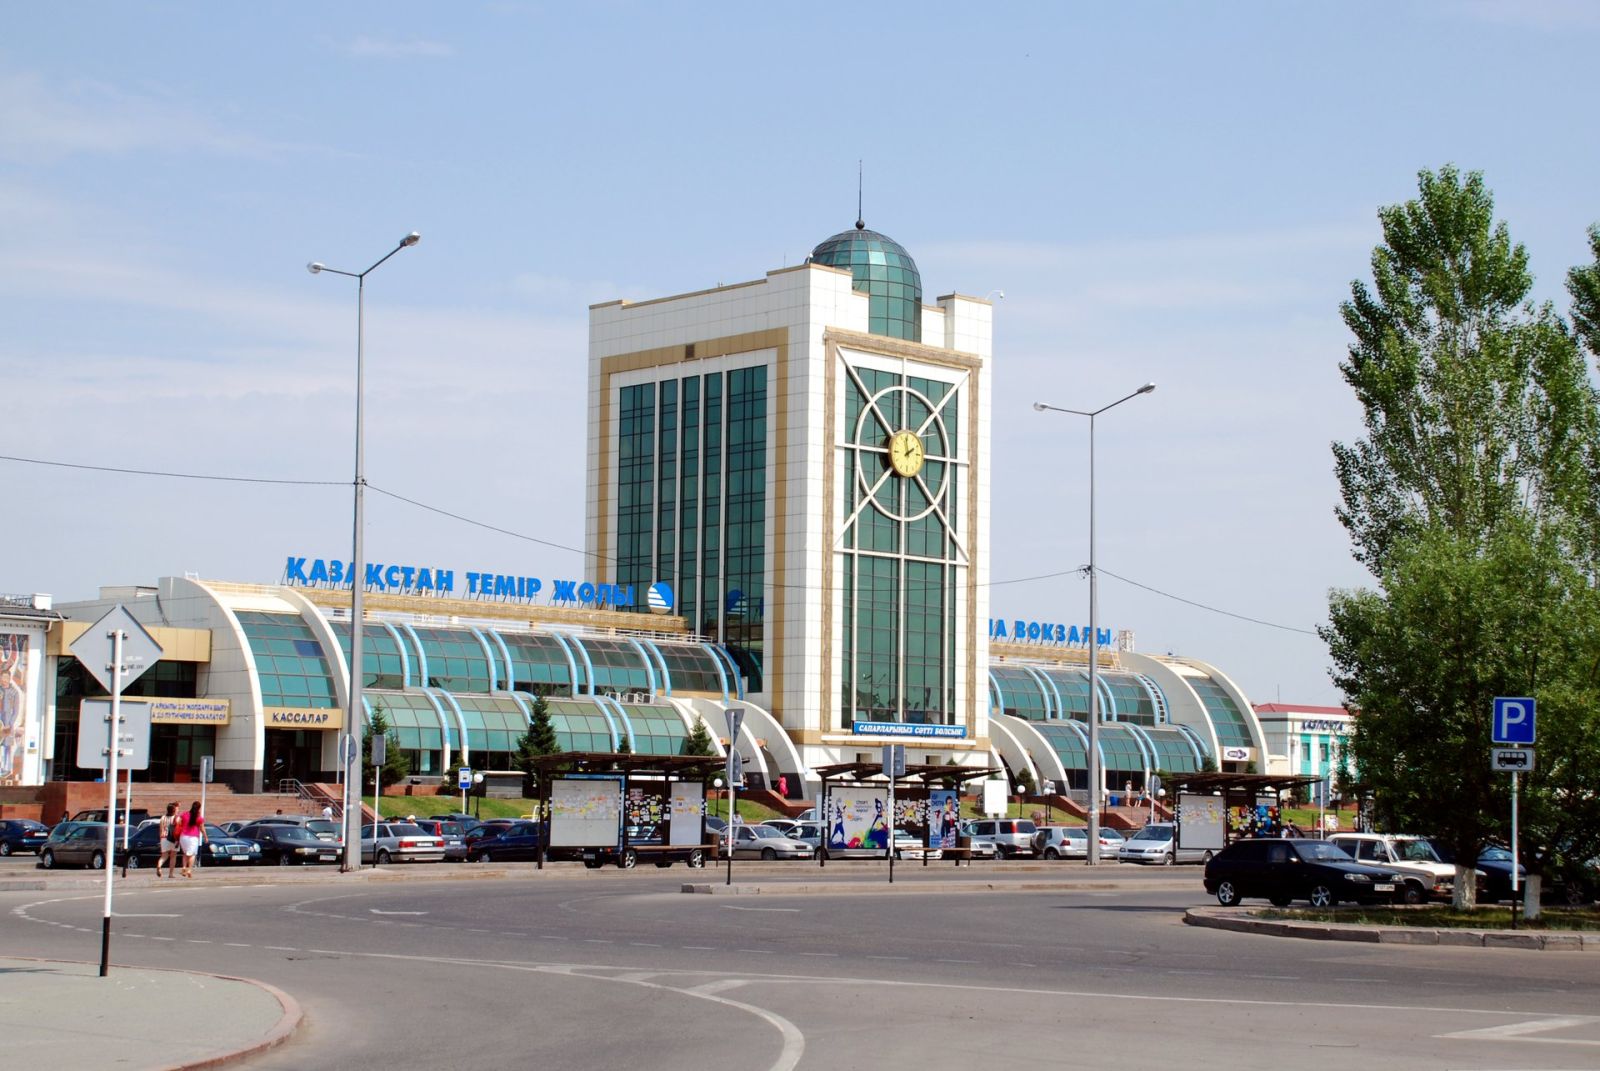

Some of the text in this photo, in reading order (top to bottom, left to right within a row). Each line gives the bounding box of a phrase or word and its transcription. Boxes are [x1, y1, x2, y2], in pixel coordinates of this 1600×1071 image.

[466, 572, 542, 599] ТЕМІР
[552, 579, 634, 607] ЖОЛЫ
[272, 712, 329, 724] КАССАЛАР
[1501, 702, 1526, 739] P
